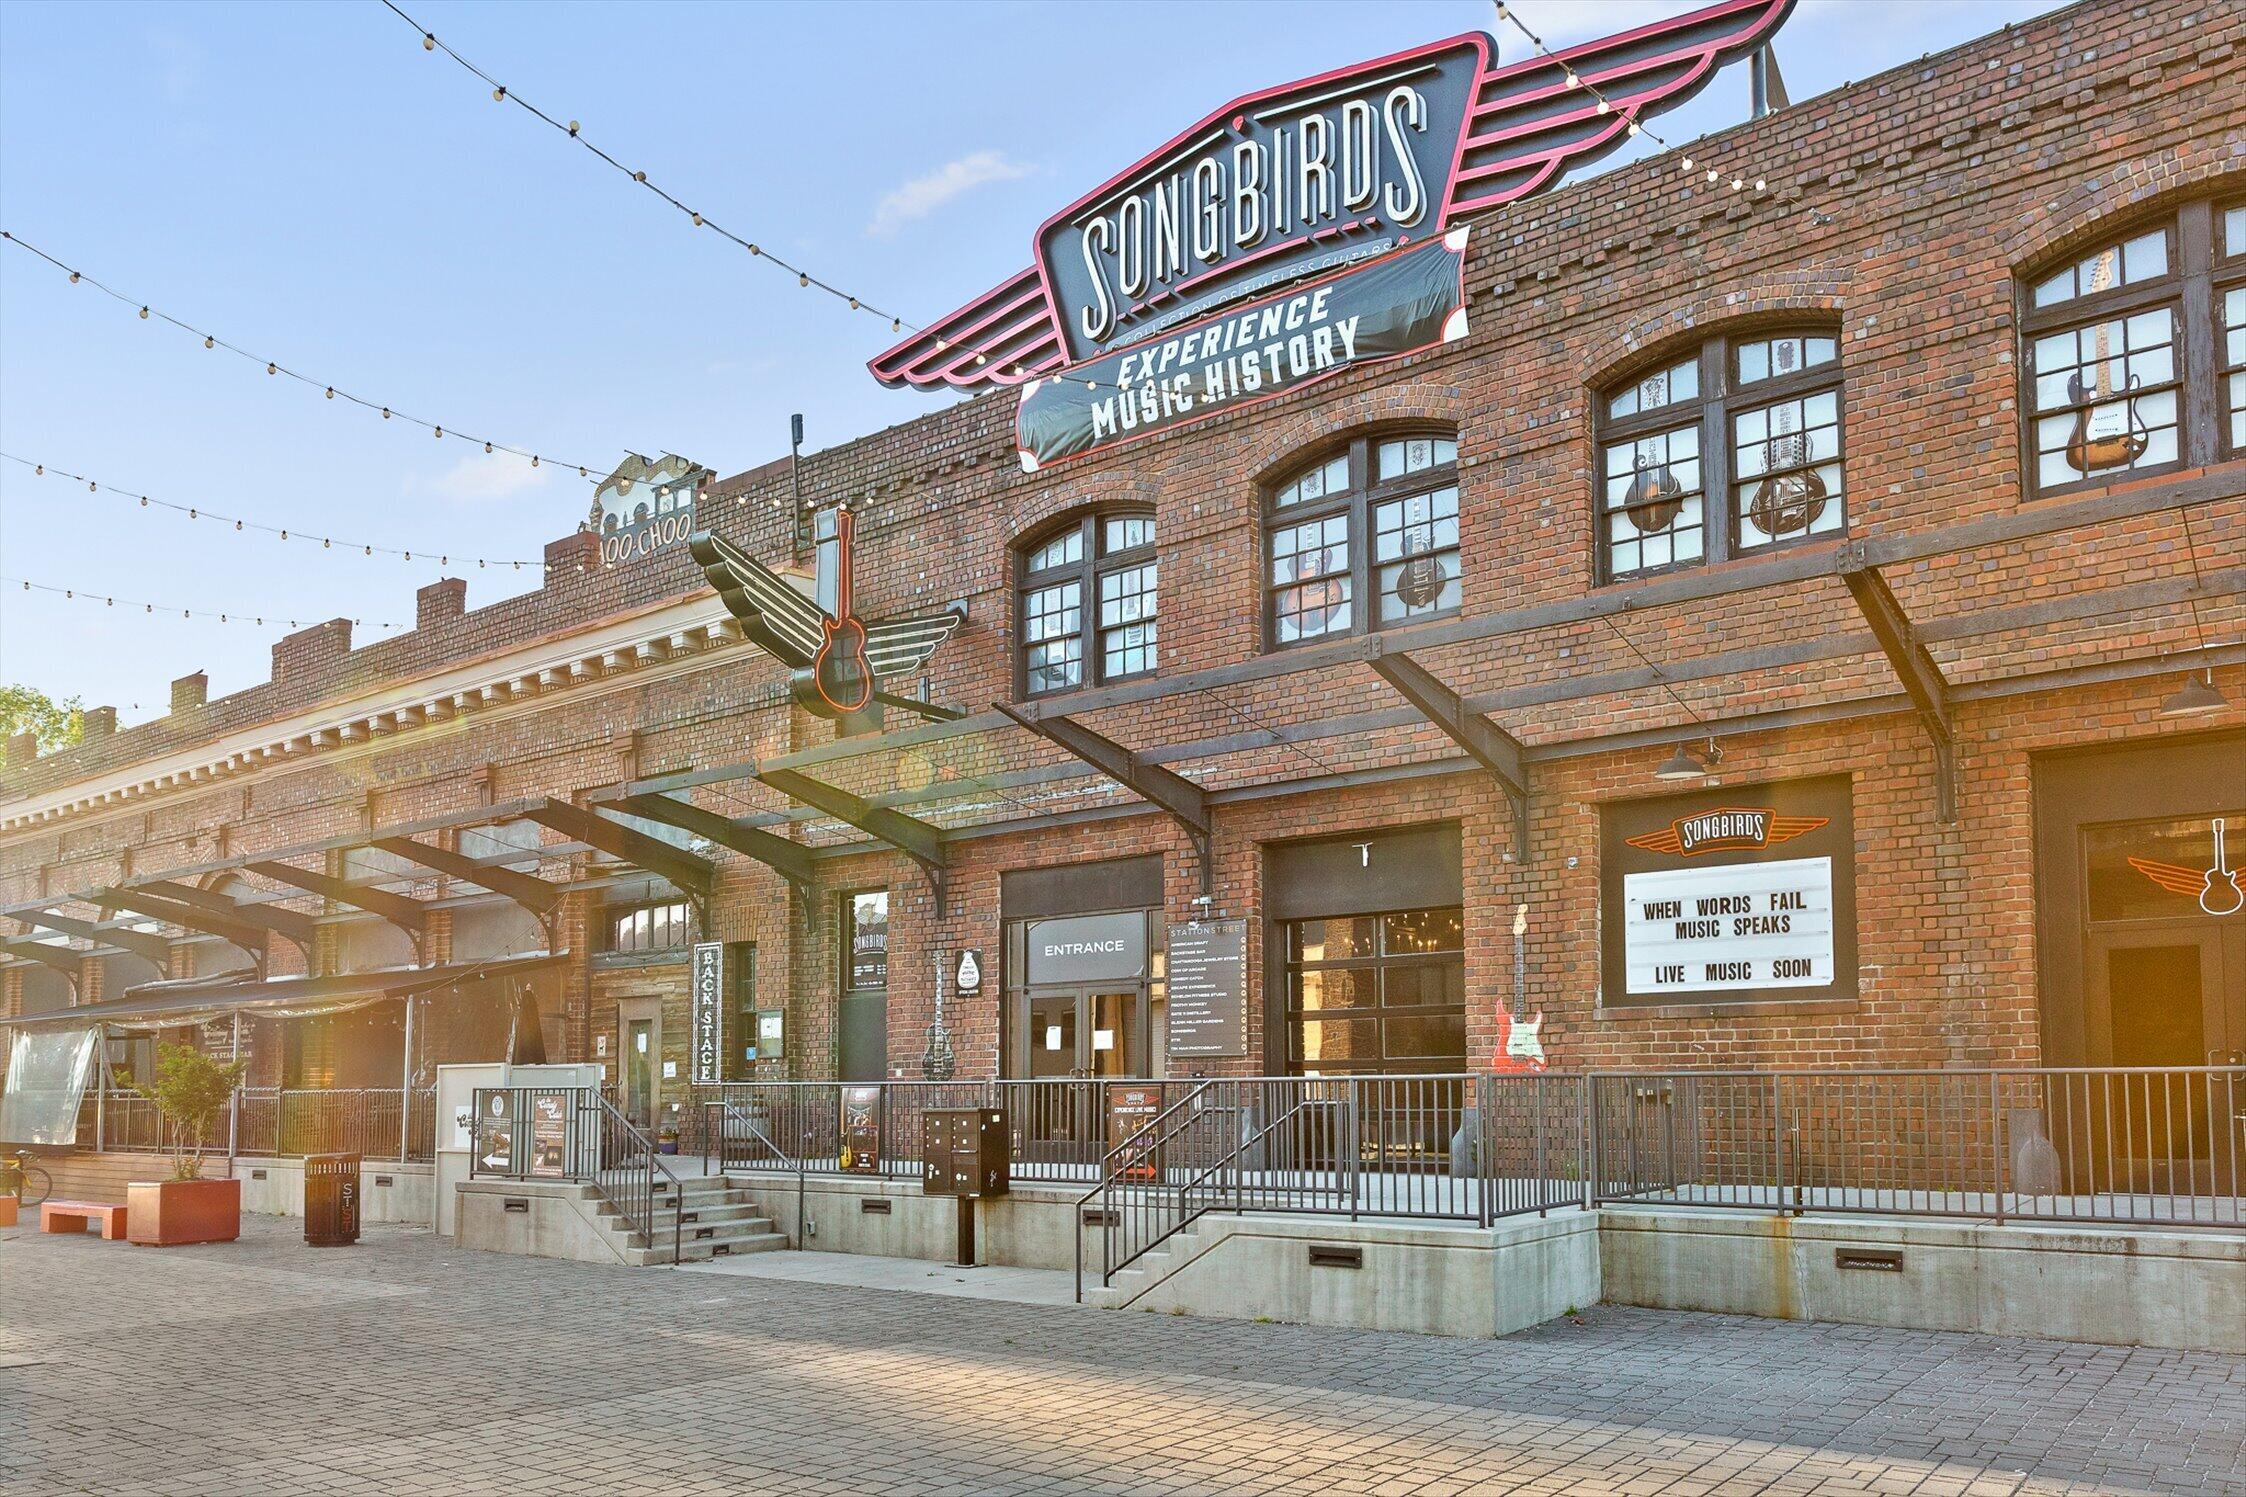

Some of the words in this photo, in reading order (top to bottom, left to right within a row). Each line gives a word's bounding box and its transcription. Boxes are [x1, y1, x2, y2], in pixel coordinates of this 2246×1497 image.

[1081, 85, 1428, 341] SONGBIRDS
[1117, 285, 1335, 388] EXPERIENCE
[1091, 372, 1195, 441] MUSIC
[1203, 315, 1361, 405] HISTORY
[1683, 814, 1764, 849] SONGBIRDS
[1643, 900, 1682, 921] WHEN
[1696, 895, 1752, 917] WORDS
[1770, 891, 1808, 911] FAIL
[1675, 919, 1720, 940] MUSIC
[1733, 915, 1792, 936] SPEAKS
[853, 934, 888, 954] SONGBIRDS
[1044, 938, 1126, 957] ENTRANCE
[702, 952, 715, 1005] BACK
[1655, 966, 1685, 984] LIVE
[1705, 962, 1752, 981] MUSIC
[1772, 959, 1812, 979] SOON
